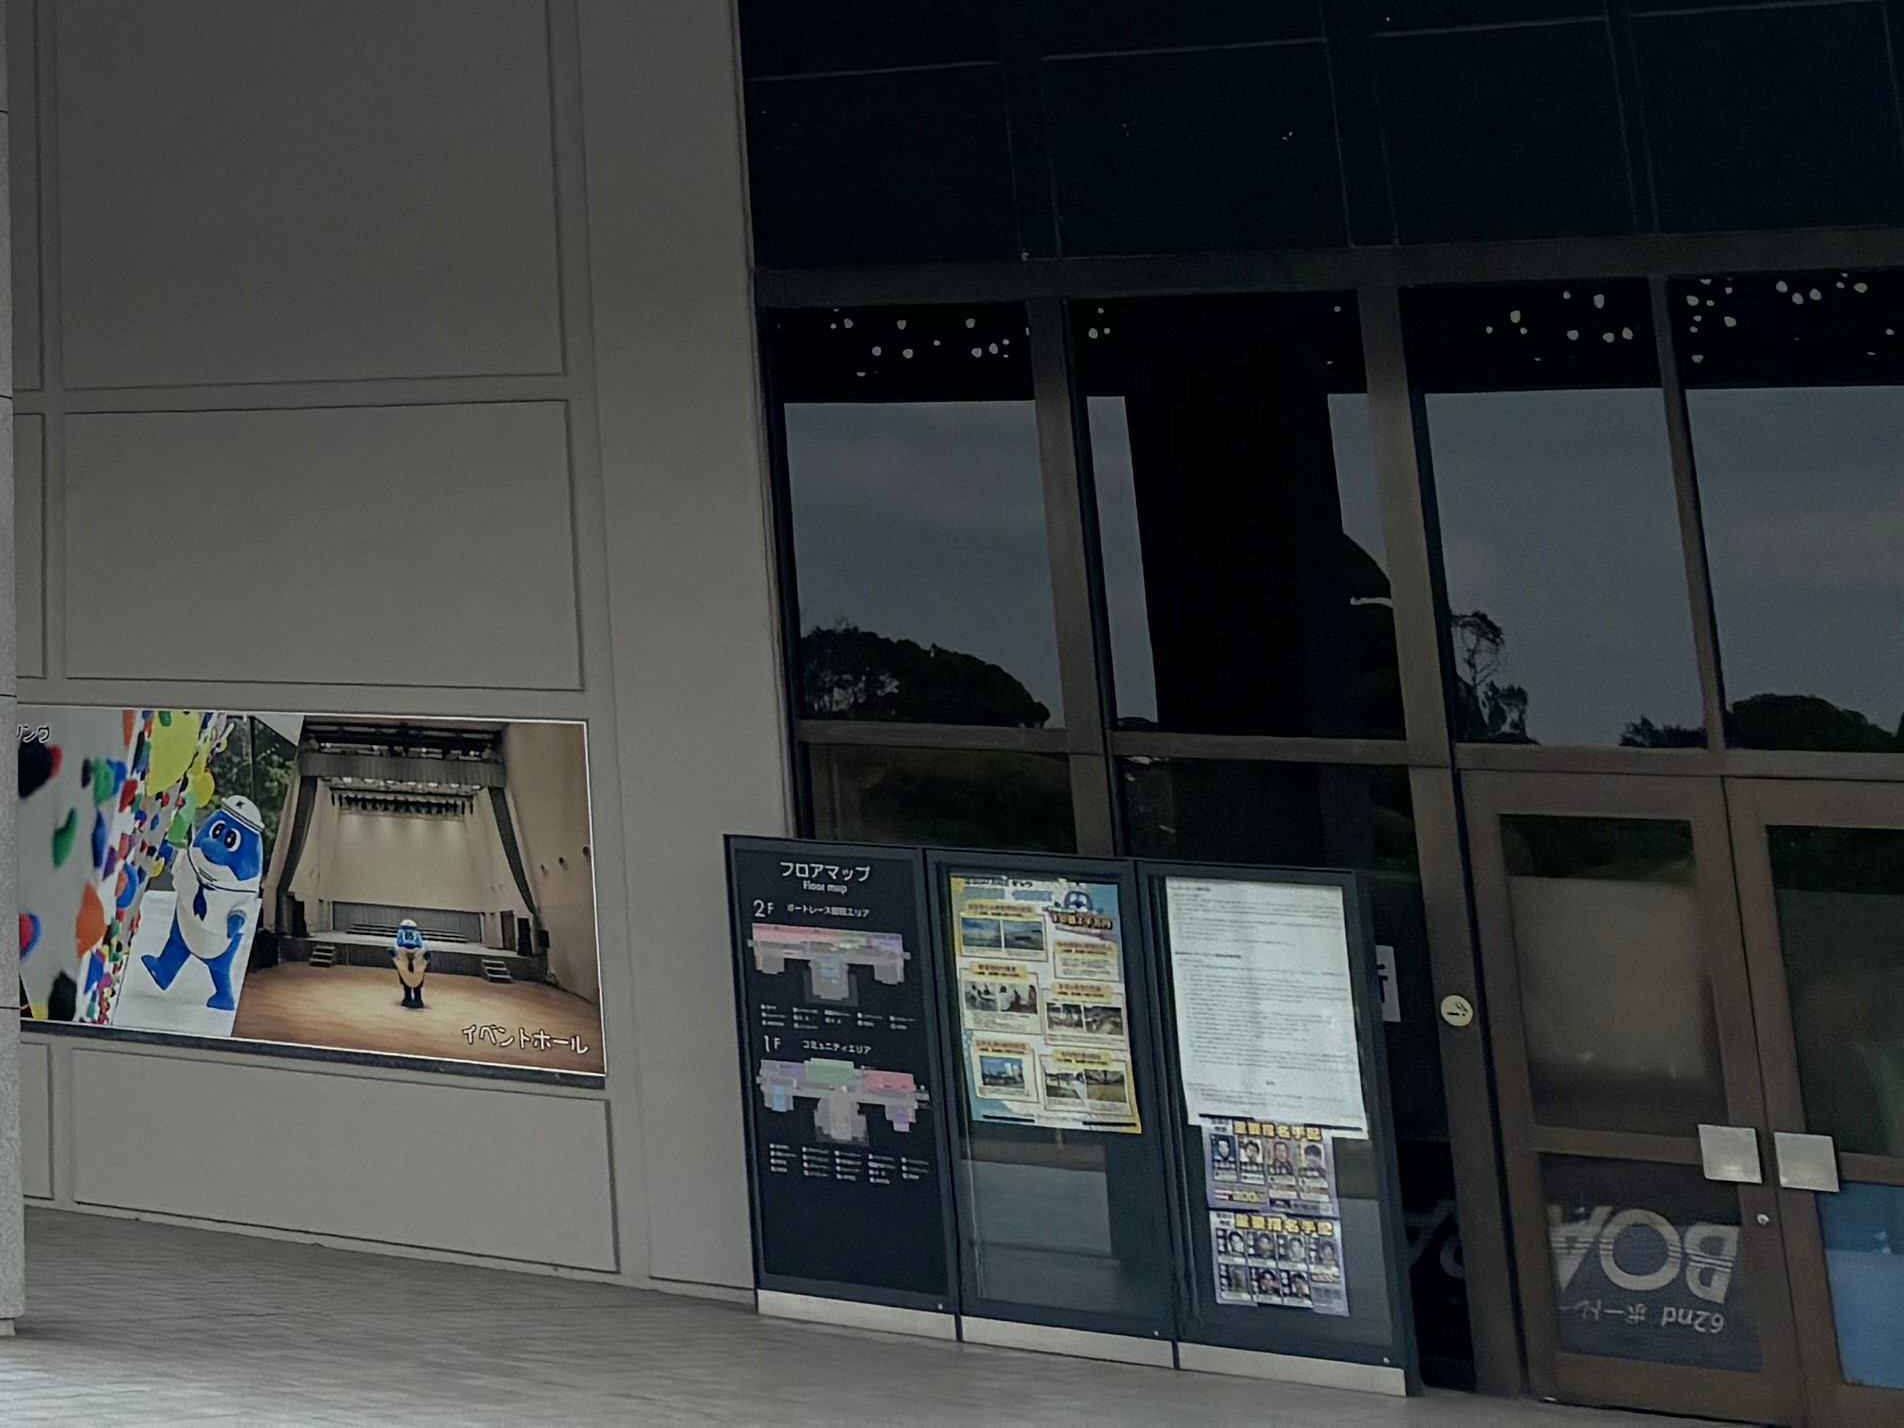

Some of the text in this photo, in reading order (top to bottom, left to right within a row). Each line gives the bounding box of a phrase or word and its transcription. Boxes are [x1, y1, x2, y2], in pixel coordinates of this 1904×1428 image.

[780, 862, 871, 882] フロアマップ
[803, 881, 848, 895] Floor map
[753, 899, 774, 917] 2F
[462, 1024, 589, 1055] イベントホール
[764, 1035, 871, 1055] 1F コミュニティエリア
[1662, 1307, 1725, 1334] 62nd
